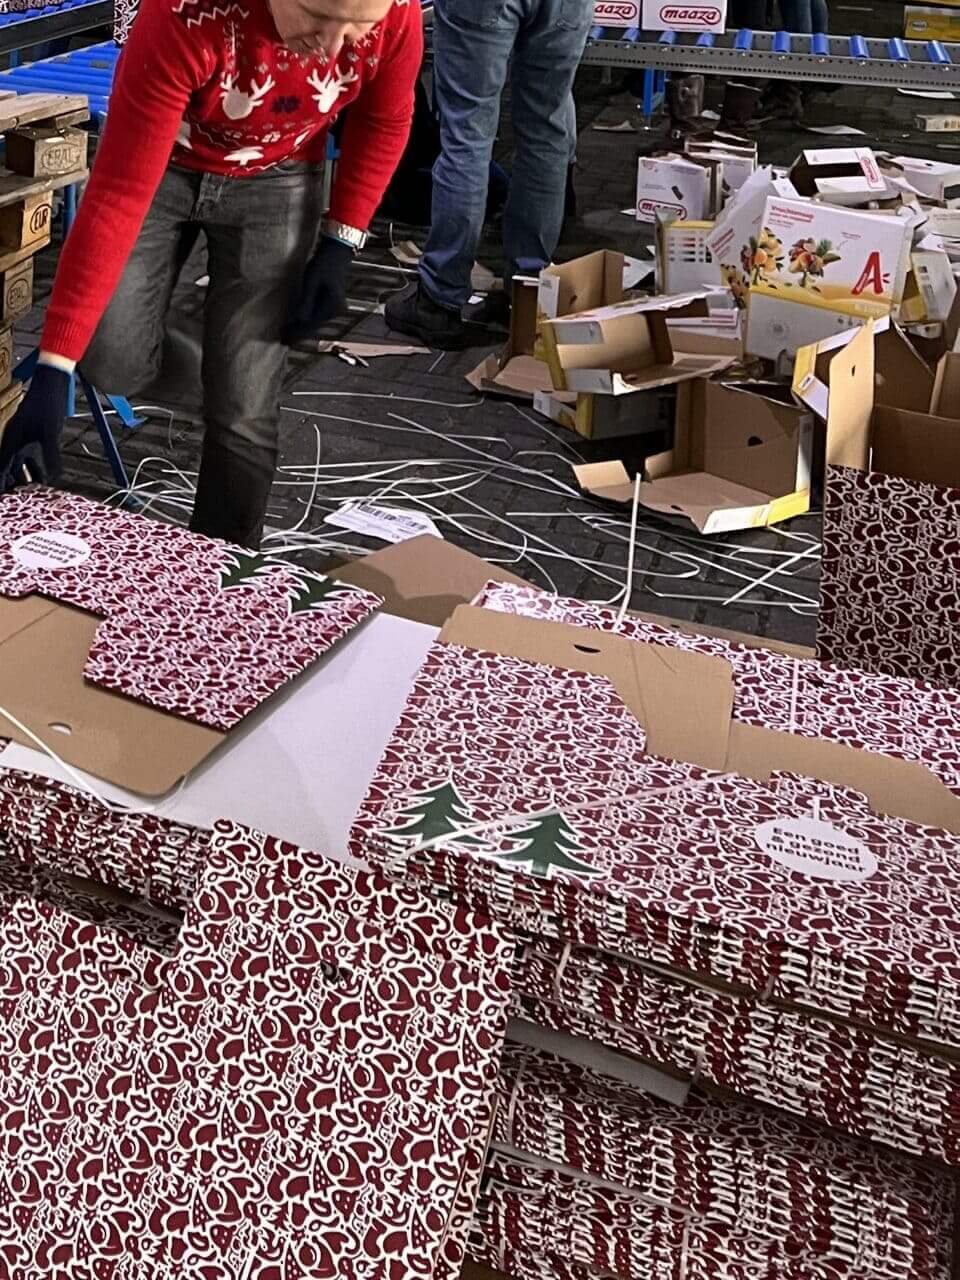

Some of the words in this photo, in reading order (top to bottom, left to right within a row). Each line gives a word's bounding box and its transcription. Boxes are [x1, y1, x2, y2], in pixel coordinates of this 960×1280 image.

[594, 5, 633, 17] aaza
[663, 9, 718, 22] maaza
[851, 251, 885, 296] A
[772, 827, 807, 841] Een
[810, 838, 860, 855] goed
[789, 841, 860, 863] gezond
[766, 842, 865, 872] nieuwjaar
